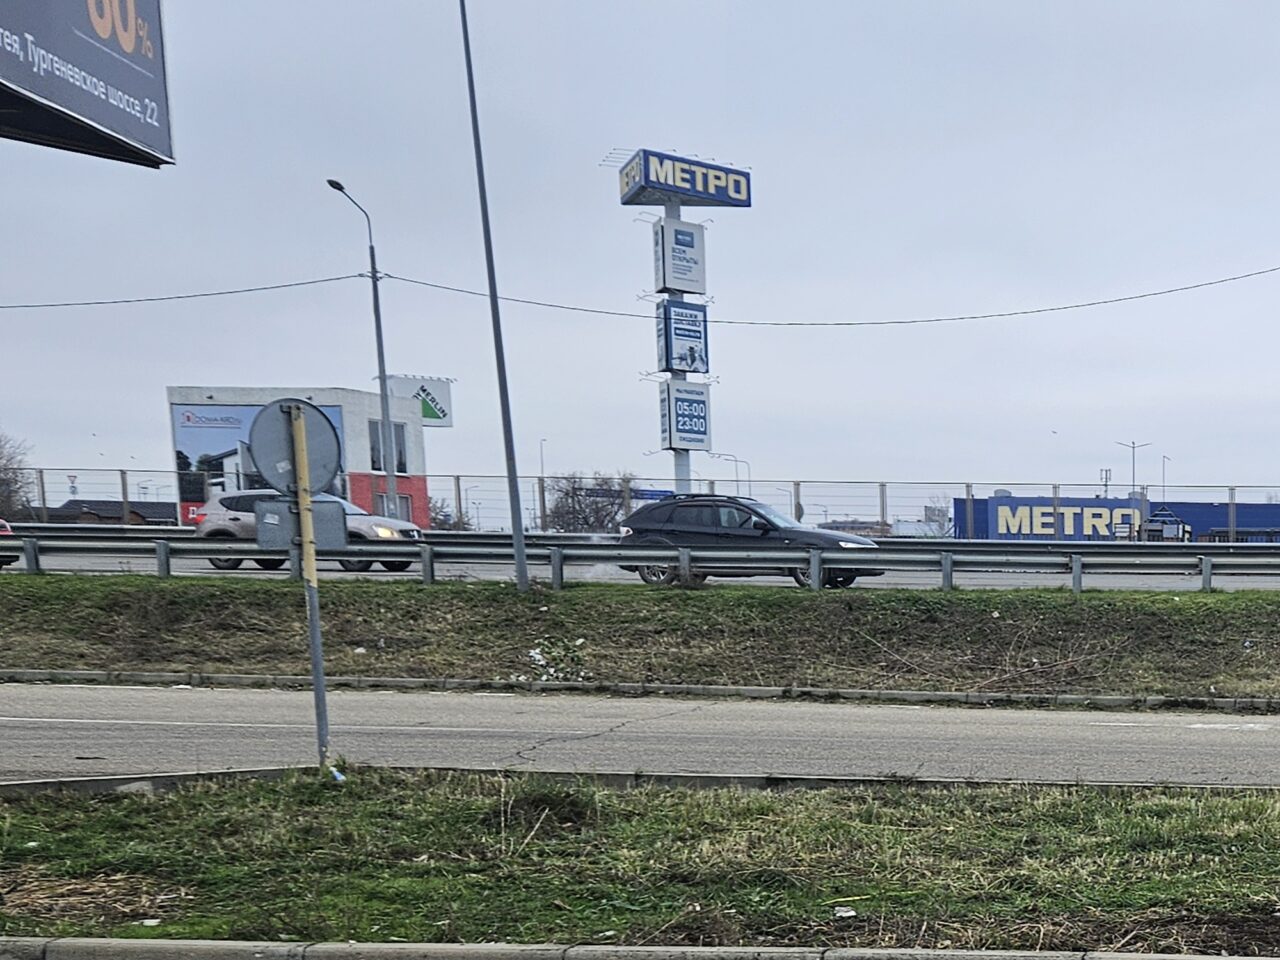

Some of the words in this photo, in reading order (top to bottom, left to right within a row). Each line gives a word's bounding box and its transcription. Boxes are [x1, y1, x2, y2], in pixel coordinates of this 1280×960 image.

[24, 32, 106, 100] Тургеневское
[107, 84, 144, 123] шоссе,
[144, 98, 160, 127] 22
[649, 155, 748, 200] МЕТРО
[419, 384, 448, 418] MERLIN
[676, 401, 706, 416] 05:00
[677, 416, 706, 431] 23:00
[997, 505, 1141, 536] METRO
